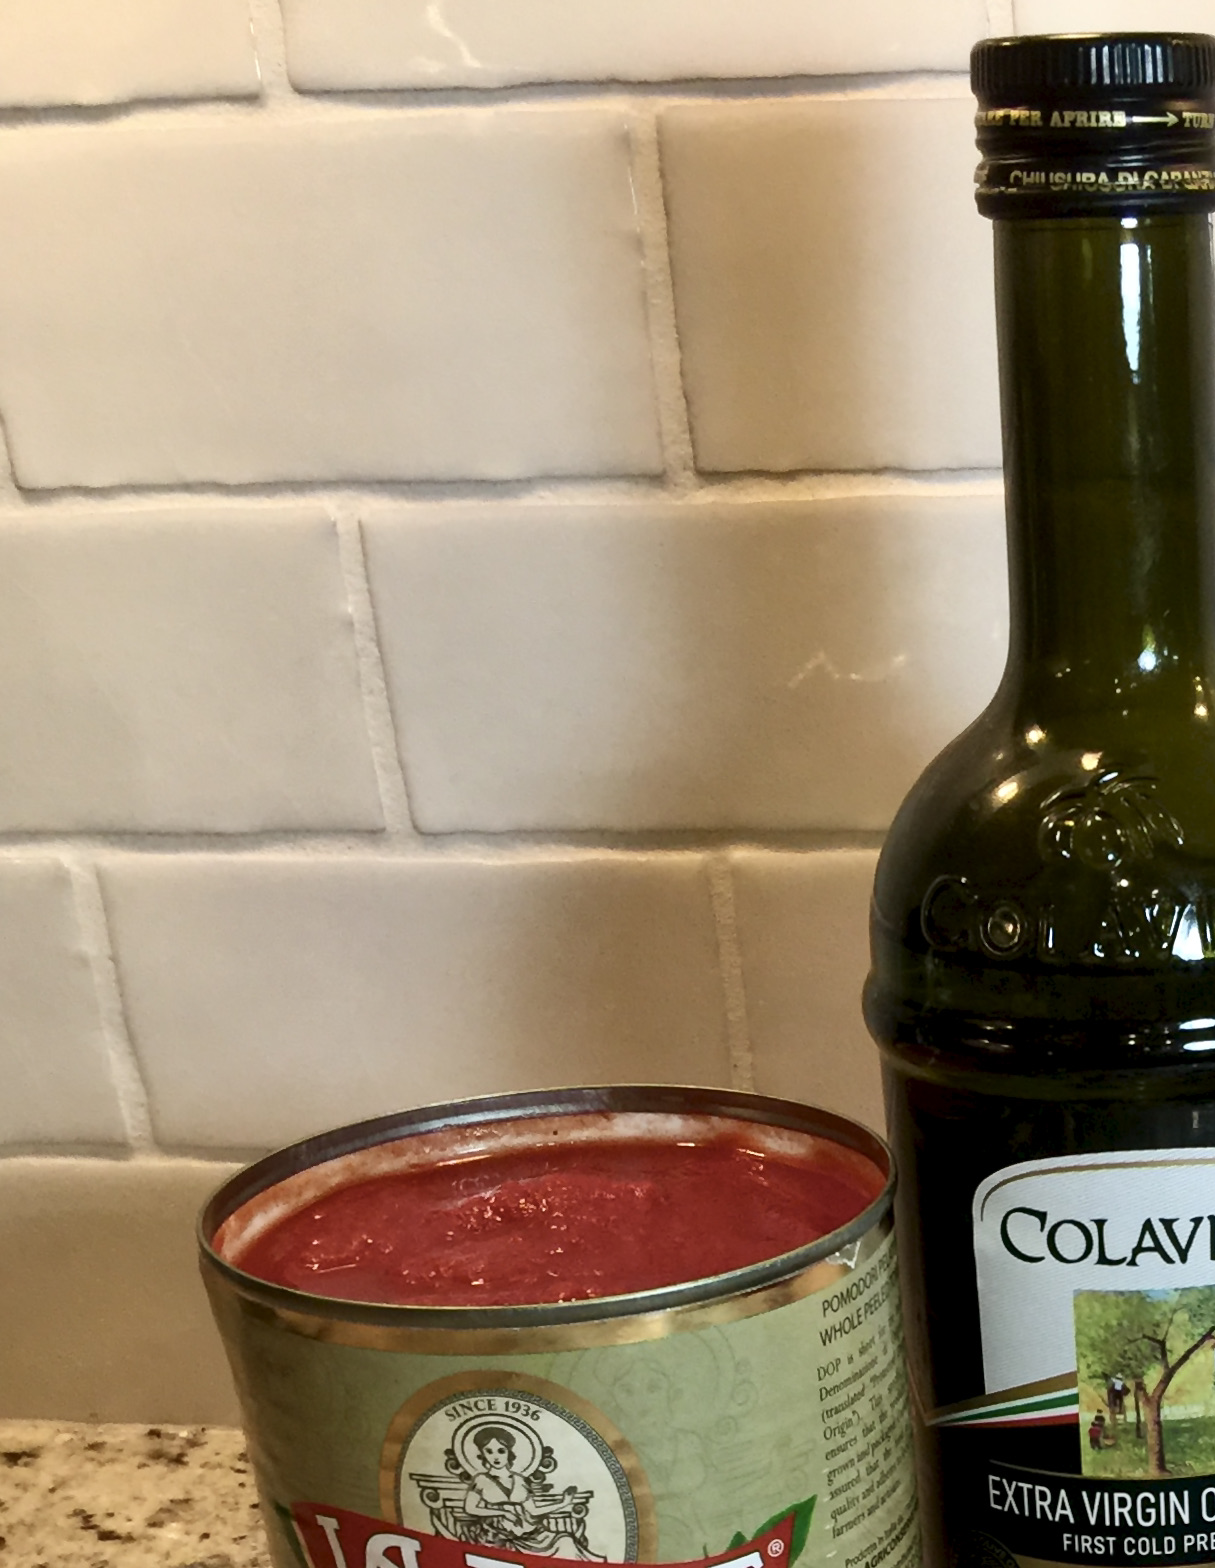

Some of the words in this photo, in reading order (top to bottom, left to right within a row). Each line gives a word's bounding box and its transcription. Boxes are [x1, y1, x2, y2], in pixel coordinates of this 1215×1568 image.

[819, 1307, 863, 1347] WHOLE
[816, 1357, 842, 1382] DOP
[444, 1398, 498, 1422] SINCE
[503, 1400, 542, 1422] 1936
[826, 1457, 856, 1487] grown
[988, 1474, 1075, 1524] EXTRA
[1081, 1490, 1190, 1527] VIRGIN
[1062, 1533, 1117, 1556] FIRST
[1123, 1536, 1176, 1556] COLD
